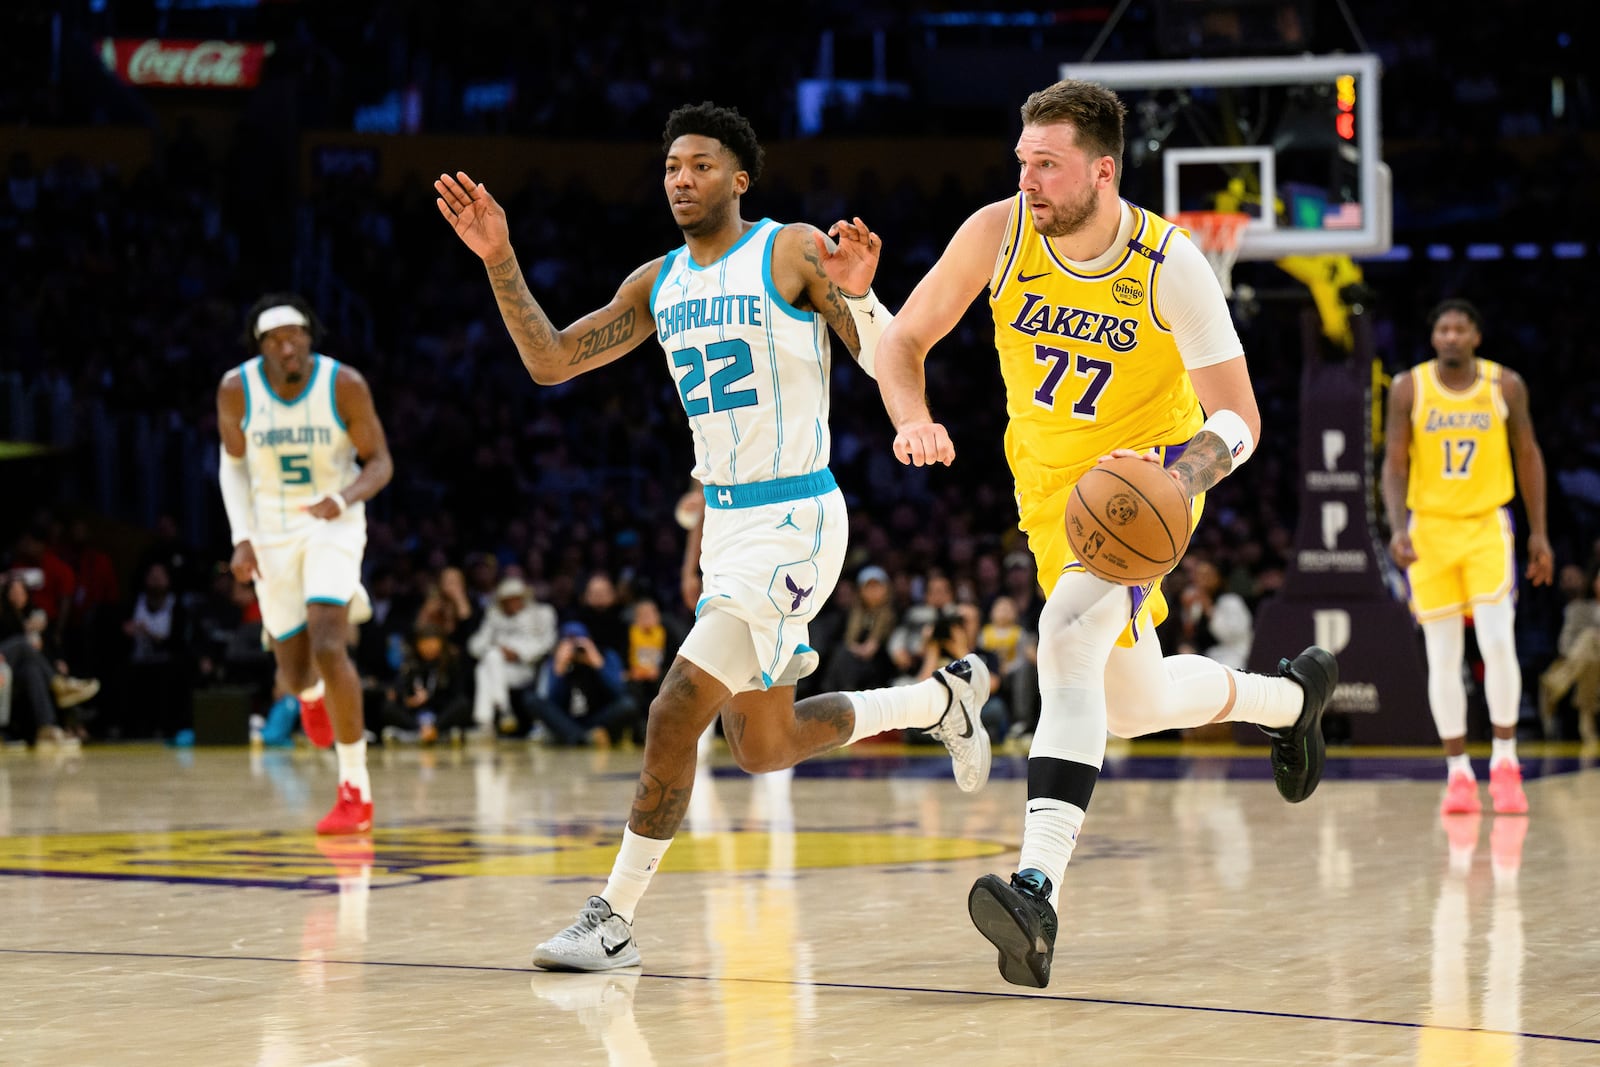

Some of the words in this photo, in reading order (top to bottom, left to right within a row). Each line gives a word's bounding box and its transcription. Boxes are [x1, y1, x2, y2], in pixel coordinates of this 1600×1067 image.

[1140, 246, 1151, 257] 44
[1115, 283, 1143, 300] bibigo
[568, 306, 637, 366] FLASH
[656, 295, 762, 343] CHARLOTTE
[1009, 292, 1139, 353] LAKERS
[672, 338, 759, 417] 22
[1033, 344, 1113, 420] 77
[280, 454, 312, 484] 5
[1442, 439, 1475, 476] 17
